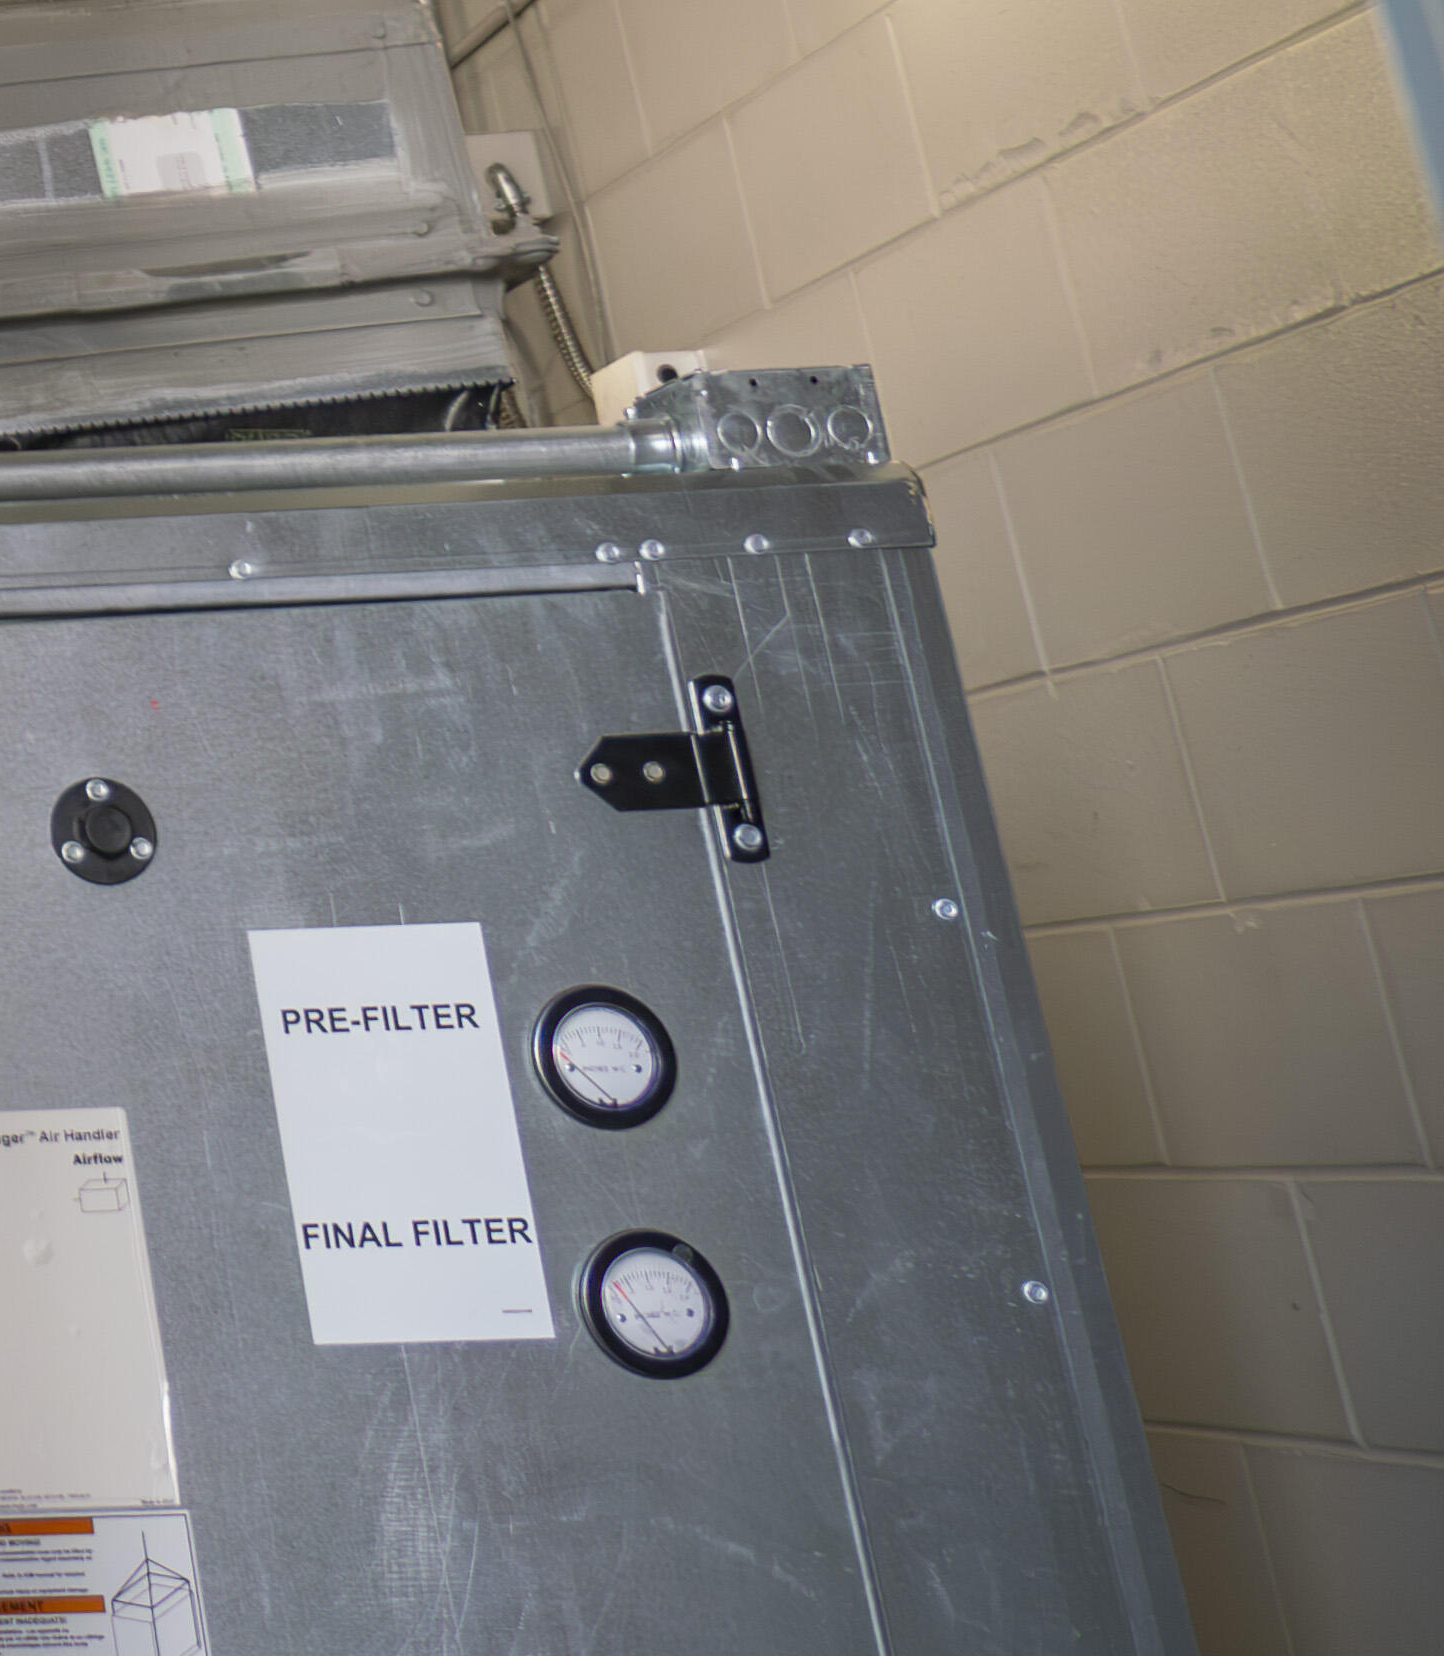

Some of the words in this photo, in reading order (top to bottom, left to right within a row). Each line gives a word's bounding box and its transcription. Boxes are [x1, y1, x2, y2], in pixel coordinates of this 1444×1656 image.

[281, 1003, 479, 1034] PRE-FILTER
[39, 1130, 60, 1143] Air
[64, 1128, 120, 1142] Handler
[72, 1153, 123, 1166] Airflow
[301, 1221, 403, 1250] FINAL
[412, 1217, 533, 1246] FILTER
